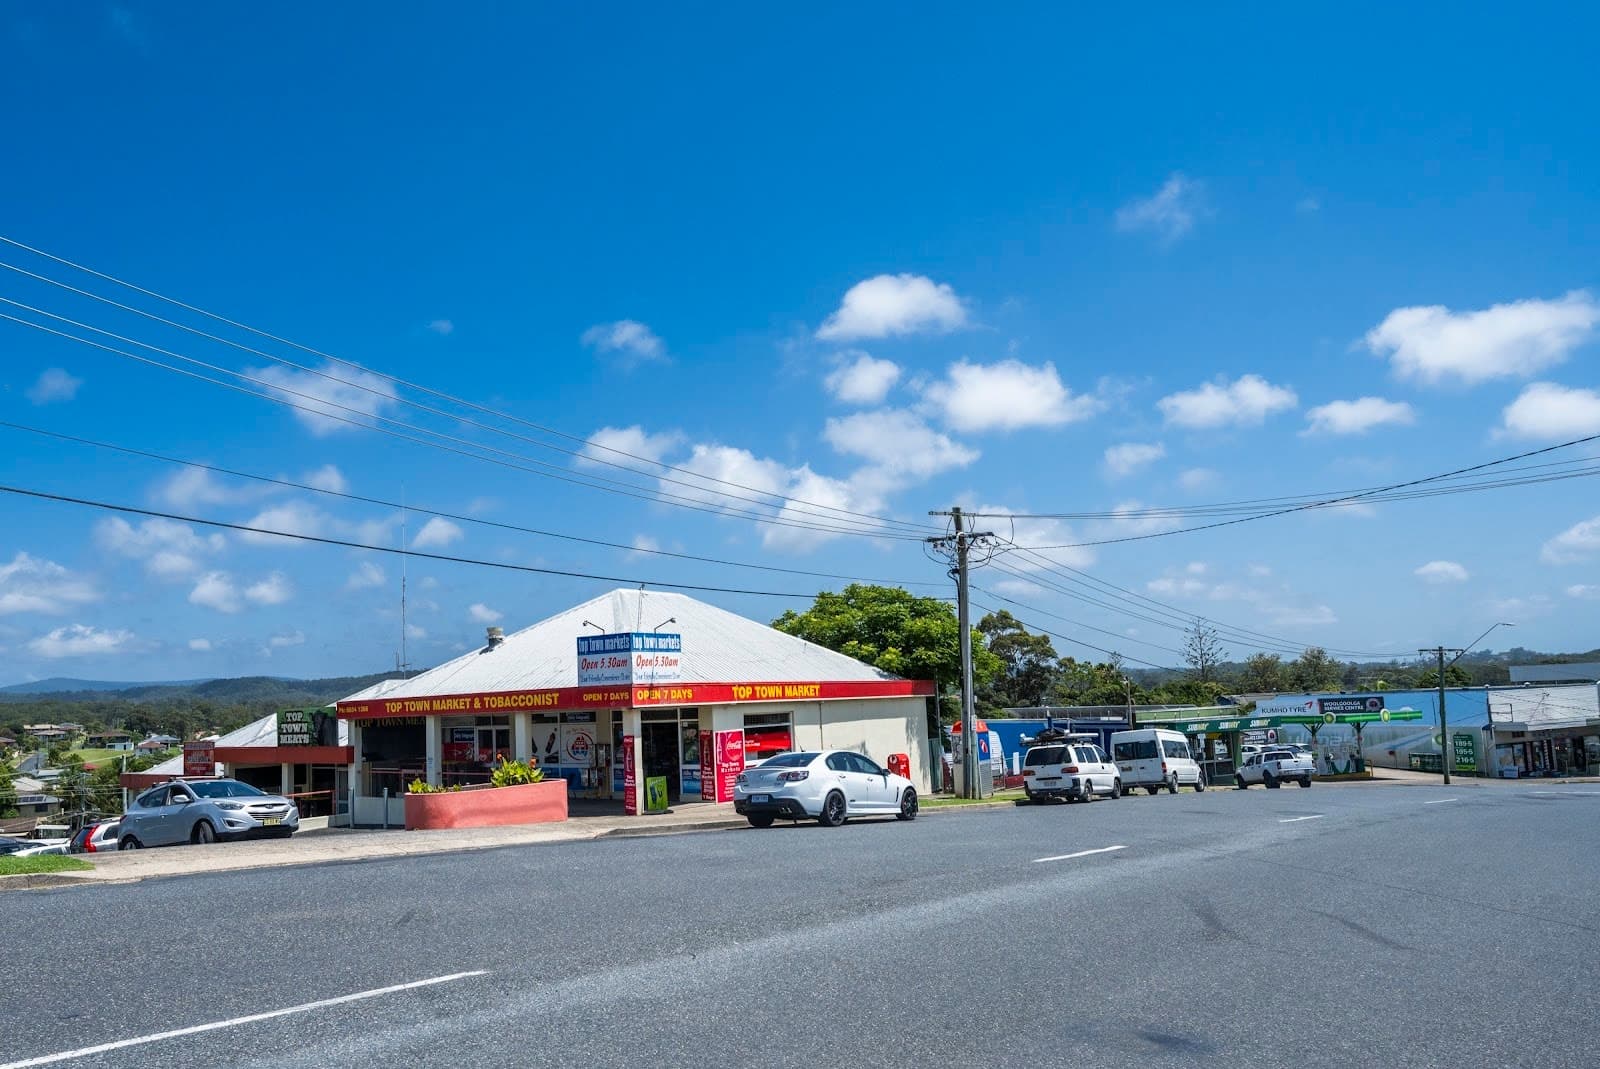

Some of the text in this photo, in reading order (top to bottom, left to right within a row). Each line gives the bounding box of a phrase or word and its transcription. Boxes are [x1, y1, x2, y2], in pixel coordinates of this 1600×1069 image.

[589, 637, 604, 651] town
[605, 635, 630, 650] markets
[643, 635, 657, 649] town
[658, 635, 680, 649] markets
[581, 657, 628, 672] Open 5.30am
[636, 655, 679, 669] Open 5.30am
[583, 692, 630, 702] OPEN 7 DAYS
[637, 689, 693, 701] OPEN 7 DAYS
[732, 684, 820, 699] TOP TOWN MARKET
[385, 693, 560, 713] TOP TOWN MARKET & TOBACCONIST
[285, 712, 303, 722] TOP
[281, 723, 308, 733] TOWN
[1186, 722, 1209, 732] SUBWAY
[1218, 720, 1241, 730] SUBWAY
[1250, 719, 1271, 728] SUBWAY
[279, 734, 310, 745] MEATS
